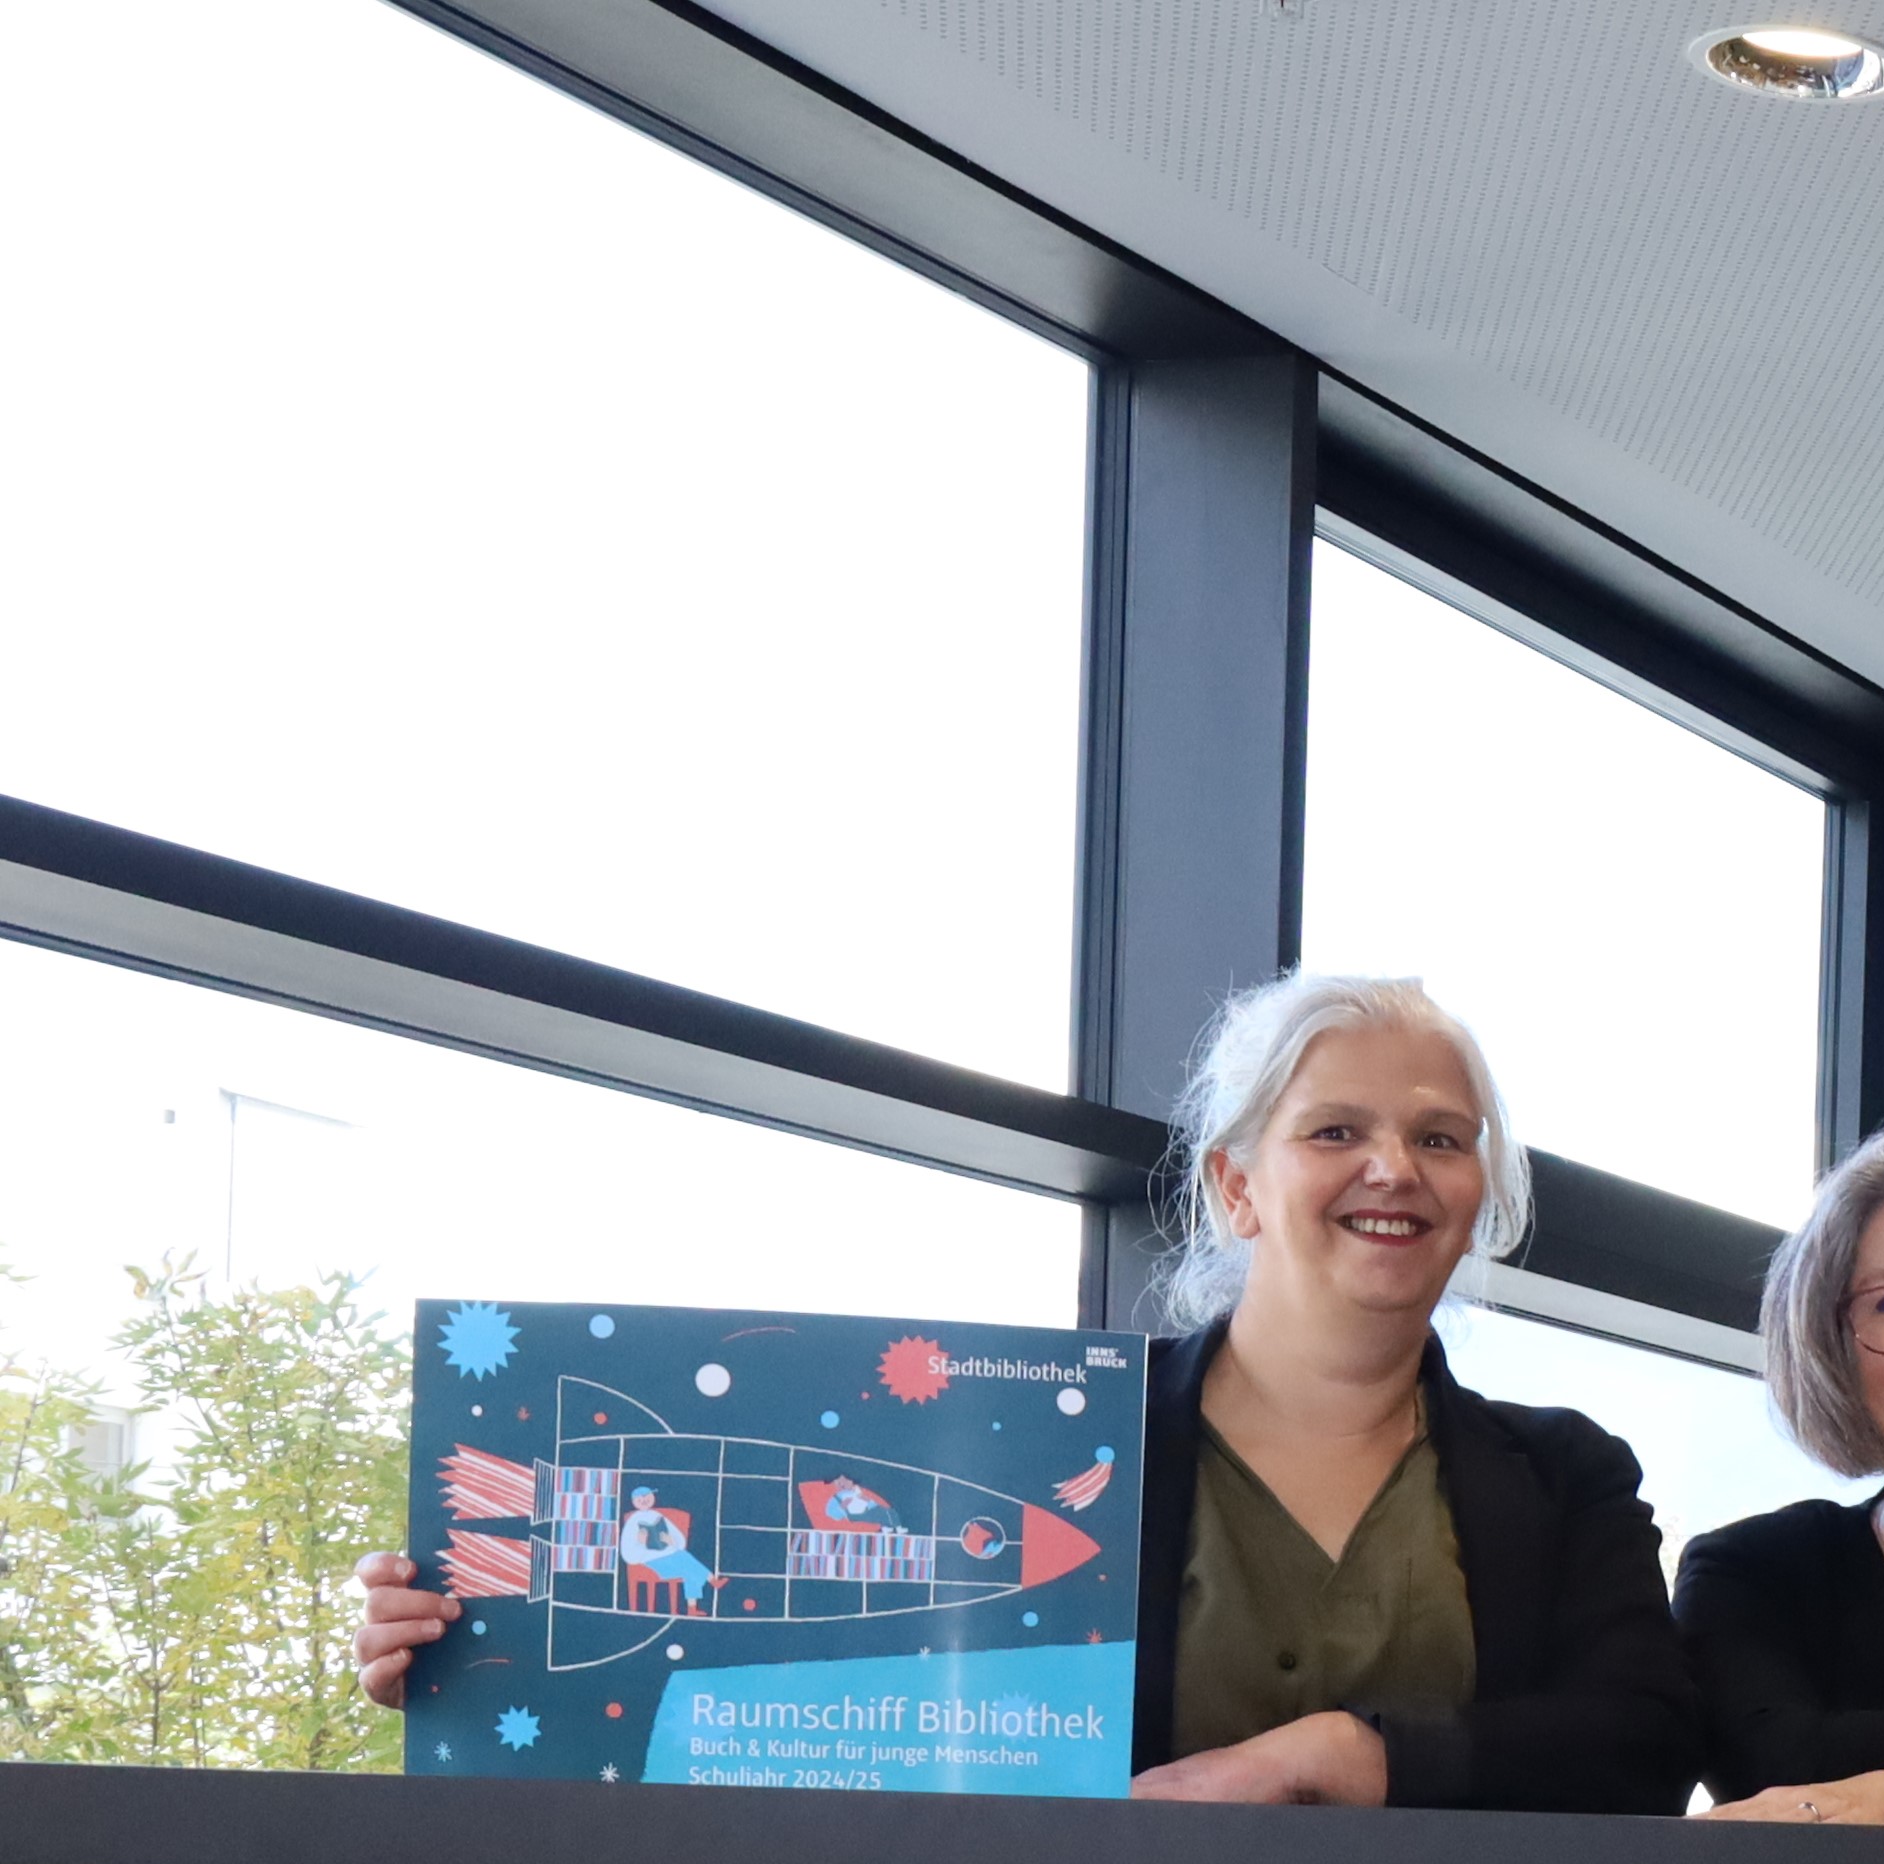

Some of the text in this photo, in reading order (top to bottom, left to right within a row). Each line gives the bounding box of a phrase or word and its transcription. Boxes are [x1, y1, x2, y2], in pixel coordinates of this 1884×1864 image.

[927, 1356, 1087, 1384] Stadtbibliothek
[1086, 1357, 1127, 1368] BRUCK
[692, 1693, 1105, 1740] Raumschiff Bibliothek
[689, 1737, 1039, 1768] Buch & Kultur für junge Menschen
[688, 1767, 882, 1791] Schuljahr 2024/25
